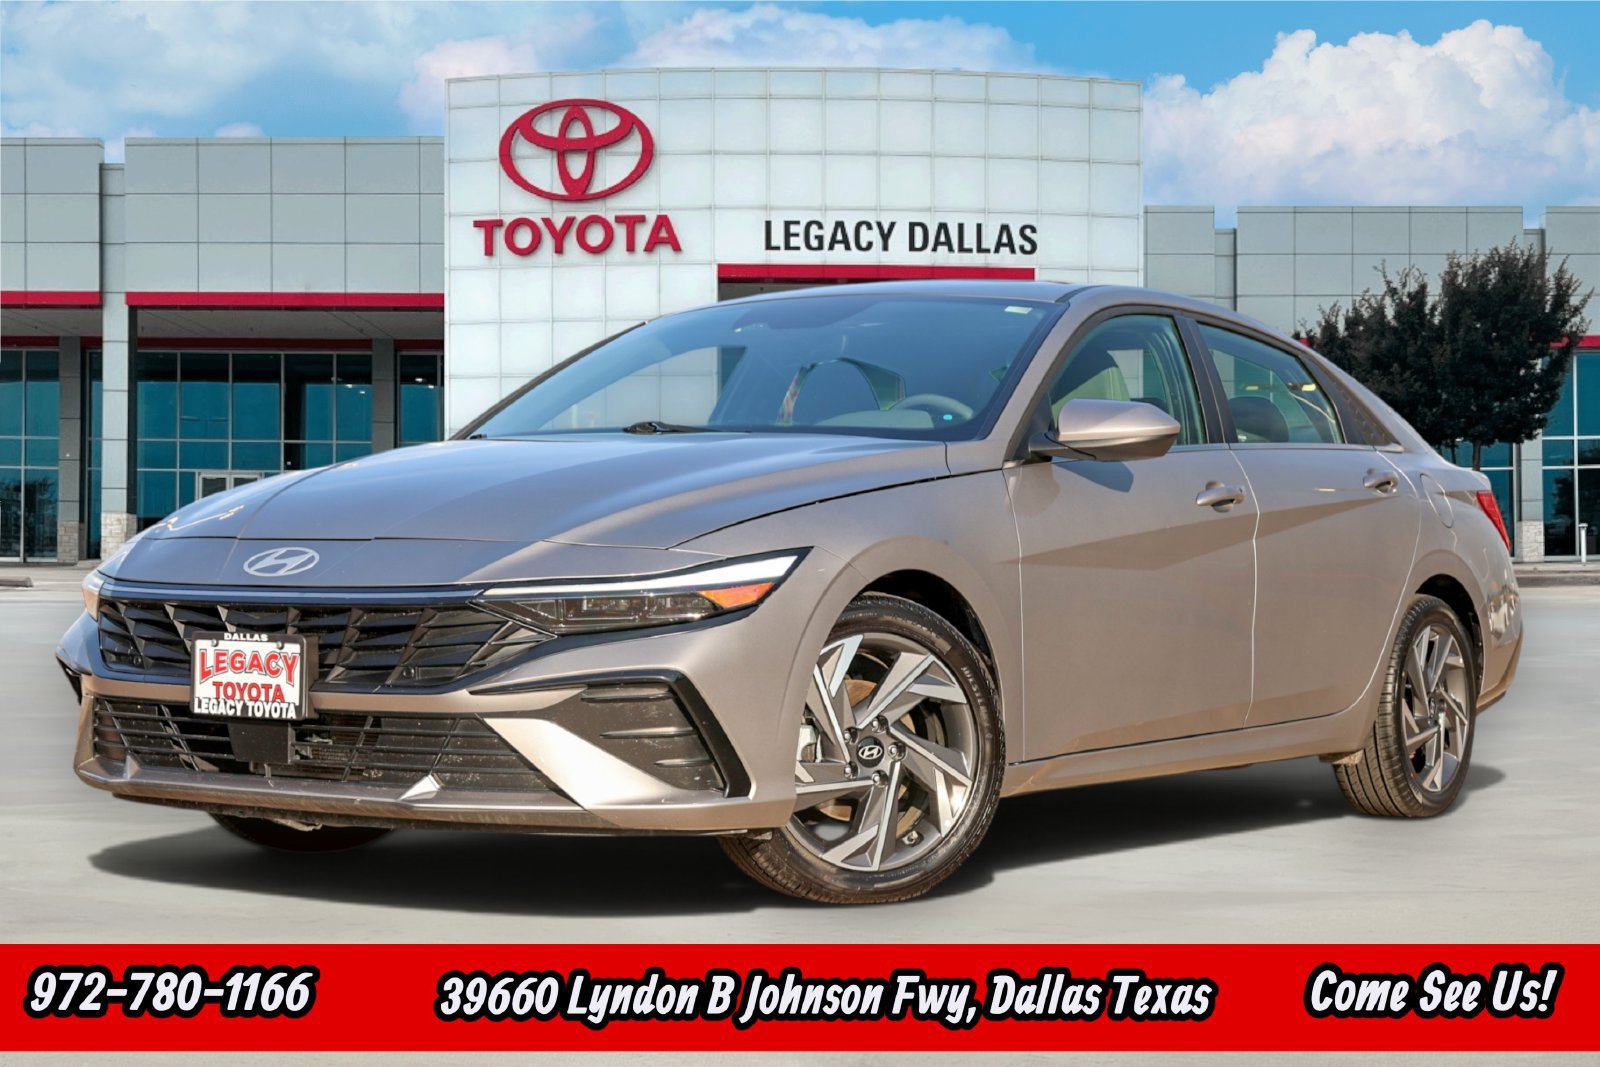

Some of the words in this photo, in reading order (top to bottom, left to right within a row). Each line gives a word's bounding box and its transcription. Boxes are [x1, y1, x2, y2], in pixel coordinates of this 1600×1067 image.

[474, 214, 682, 257] TOYOTA
[764, 220, 897, 252] LEGACY
[908, 221, 1038, 256] DALLAS
[223, 633, 269, 642] DALLAS
[200, 649, 299, 686] LEGACY
[212, 681, 286, 704] TOYOTA
[194, 697, 244, 716] LEGACY
[246, 701, 297, 719] TOYOTA
